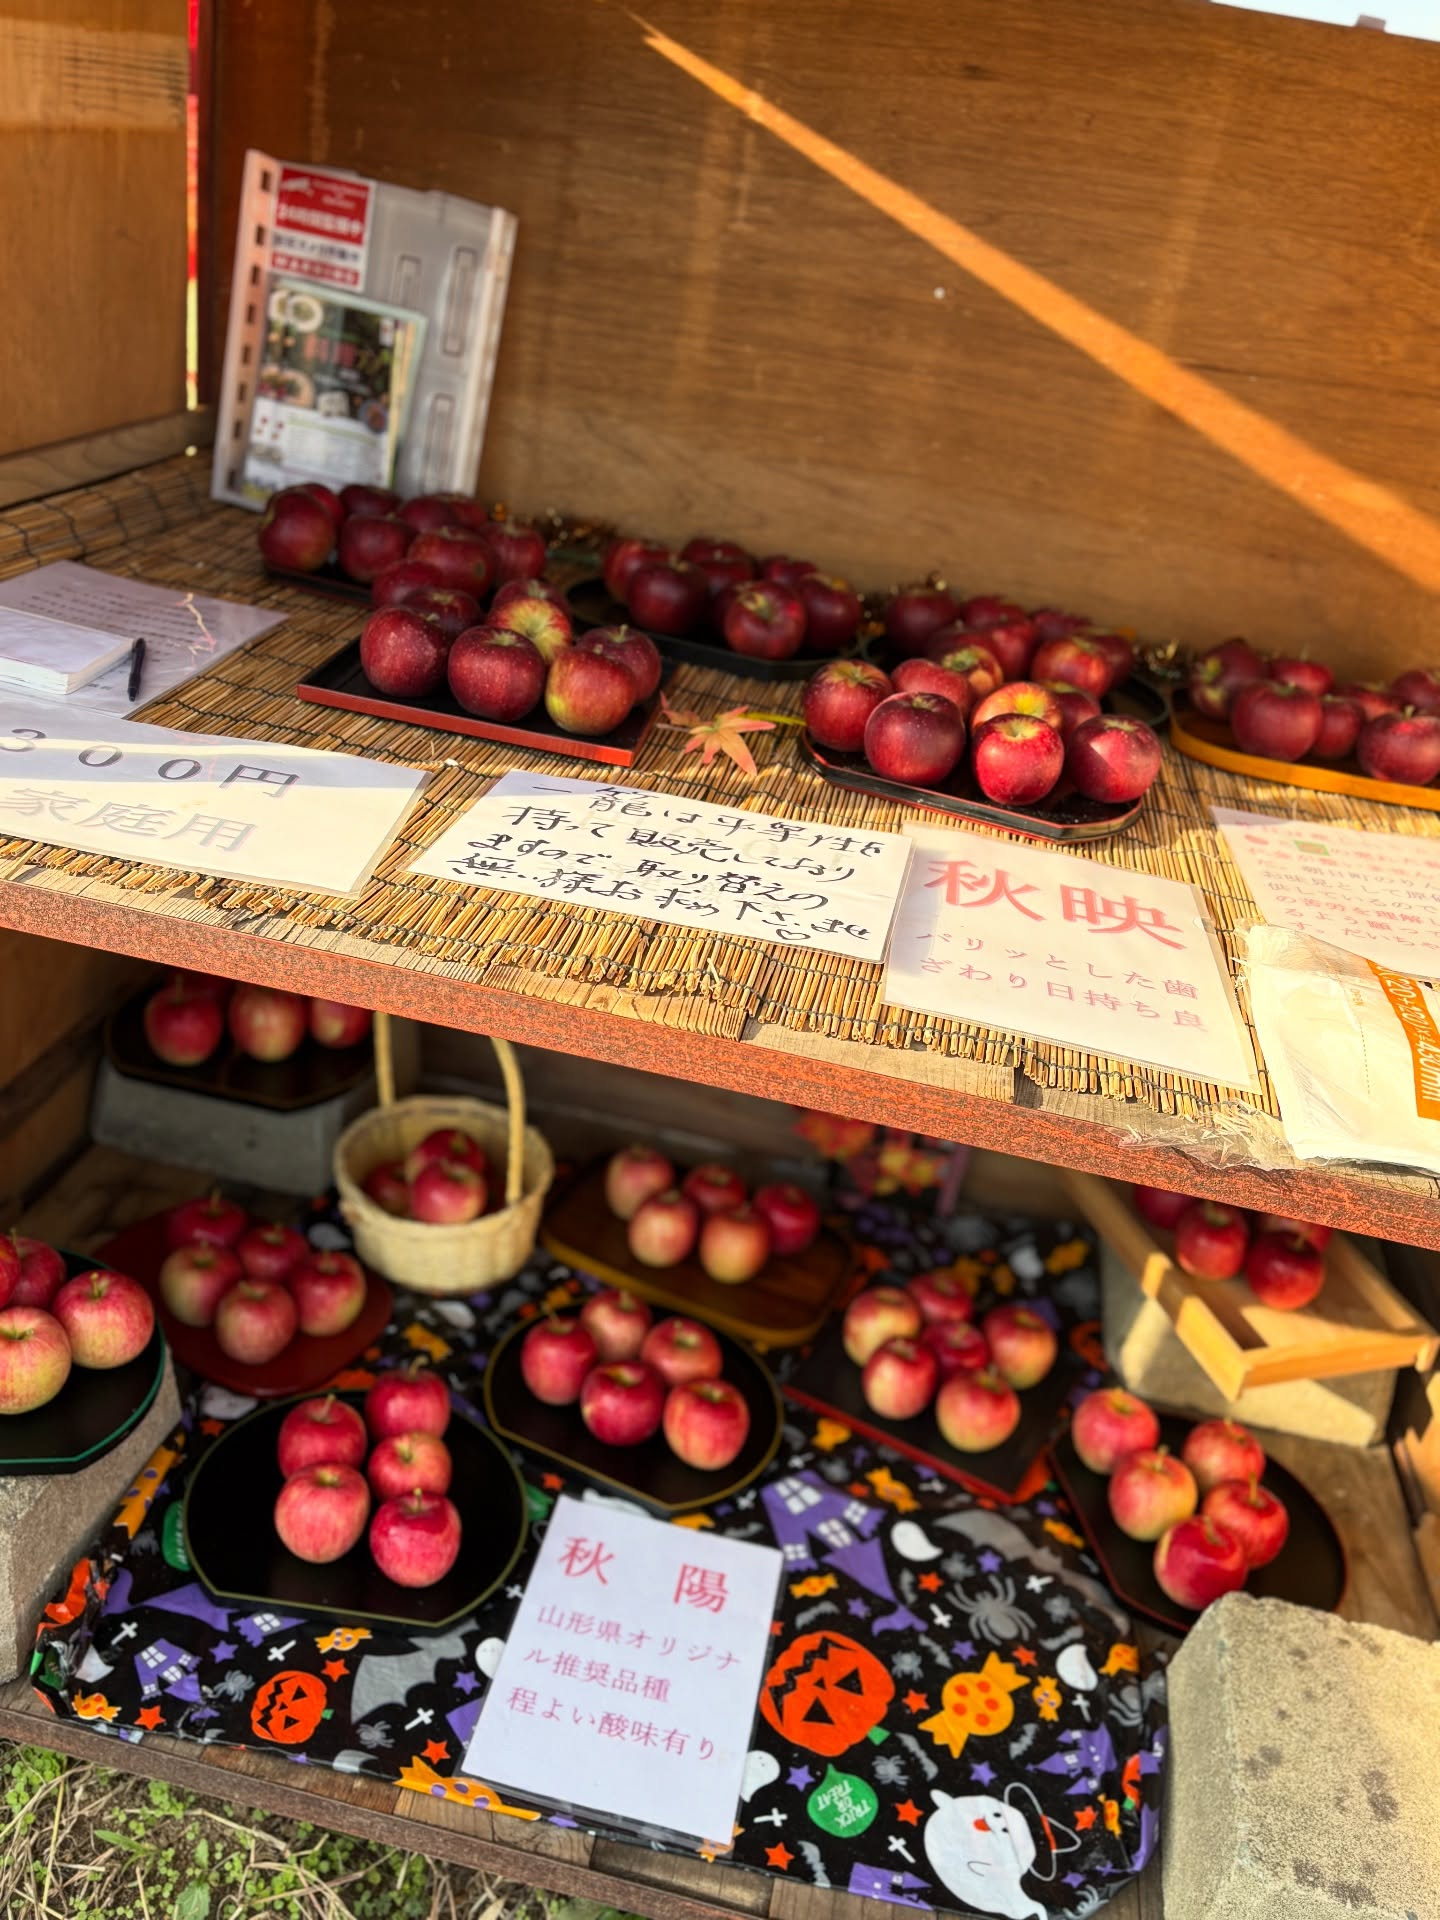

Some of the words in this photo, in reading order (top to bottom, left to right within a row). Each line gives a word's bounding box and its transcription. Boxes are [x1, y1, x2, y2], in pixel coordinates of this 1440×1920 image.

[923, 860, 1188, 950] 秋映
[915, 932, 1200, 1000] パリッとした歯
[920, 956, 1210, 1033] ざわり日持ち良
[537, 1604, 742, 1671] 山形県オリジナ
[523, 1648, 671, 1703] ル推奨品種
[509, 1686, 715, 1761] 程よい酸味有り
[817, 1780, 853, 1811] TREAT
[833, 1796, 853, 1813] OR
[834, 1799, 872, 1829] TRICK
